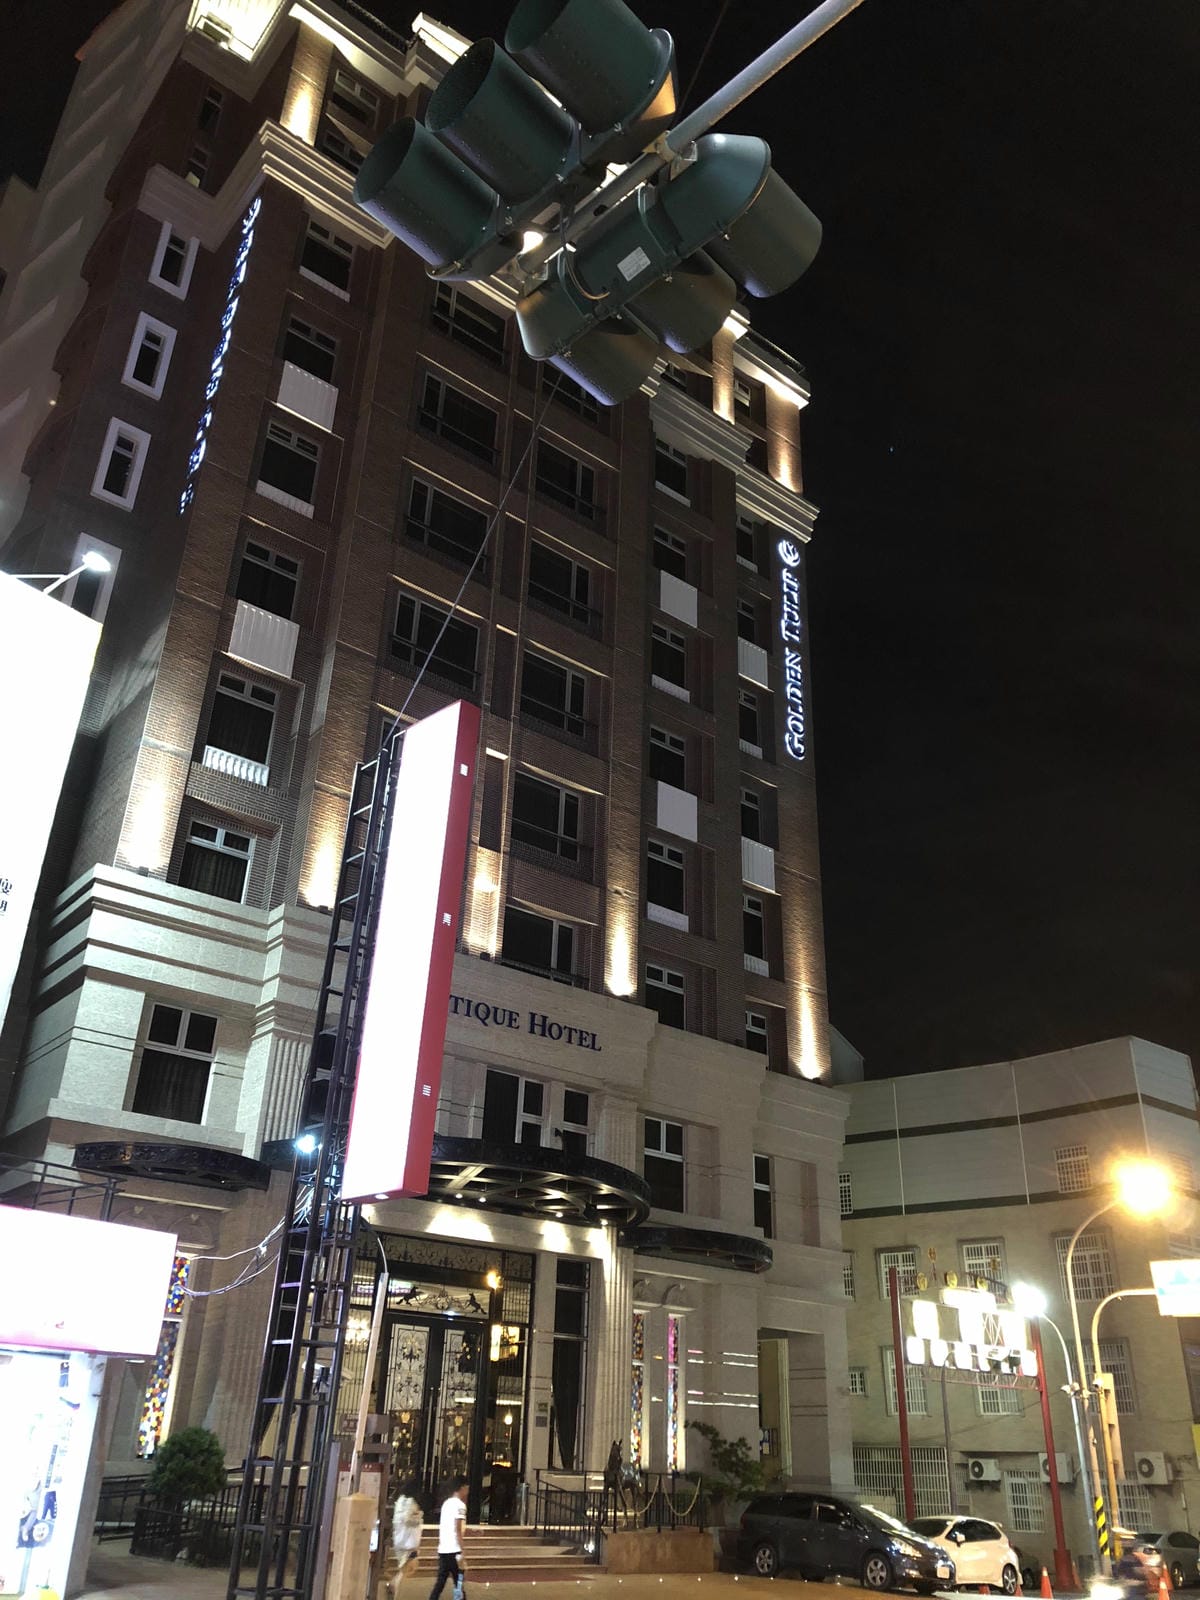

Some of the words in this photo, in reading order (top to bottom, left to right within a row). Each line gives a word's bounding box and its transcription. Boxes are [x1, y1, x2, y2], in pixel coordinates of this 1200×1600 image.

[781, 567, 801, 642] TULIP
[785, 647, 805, 760] GOLDEN
[528, 1011, 602, 1051] HOTEL
